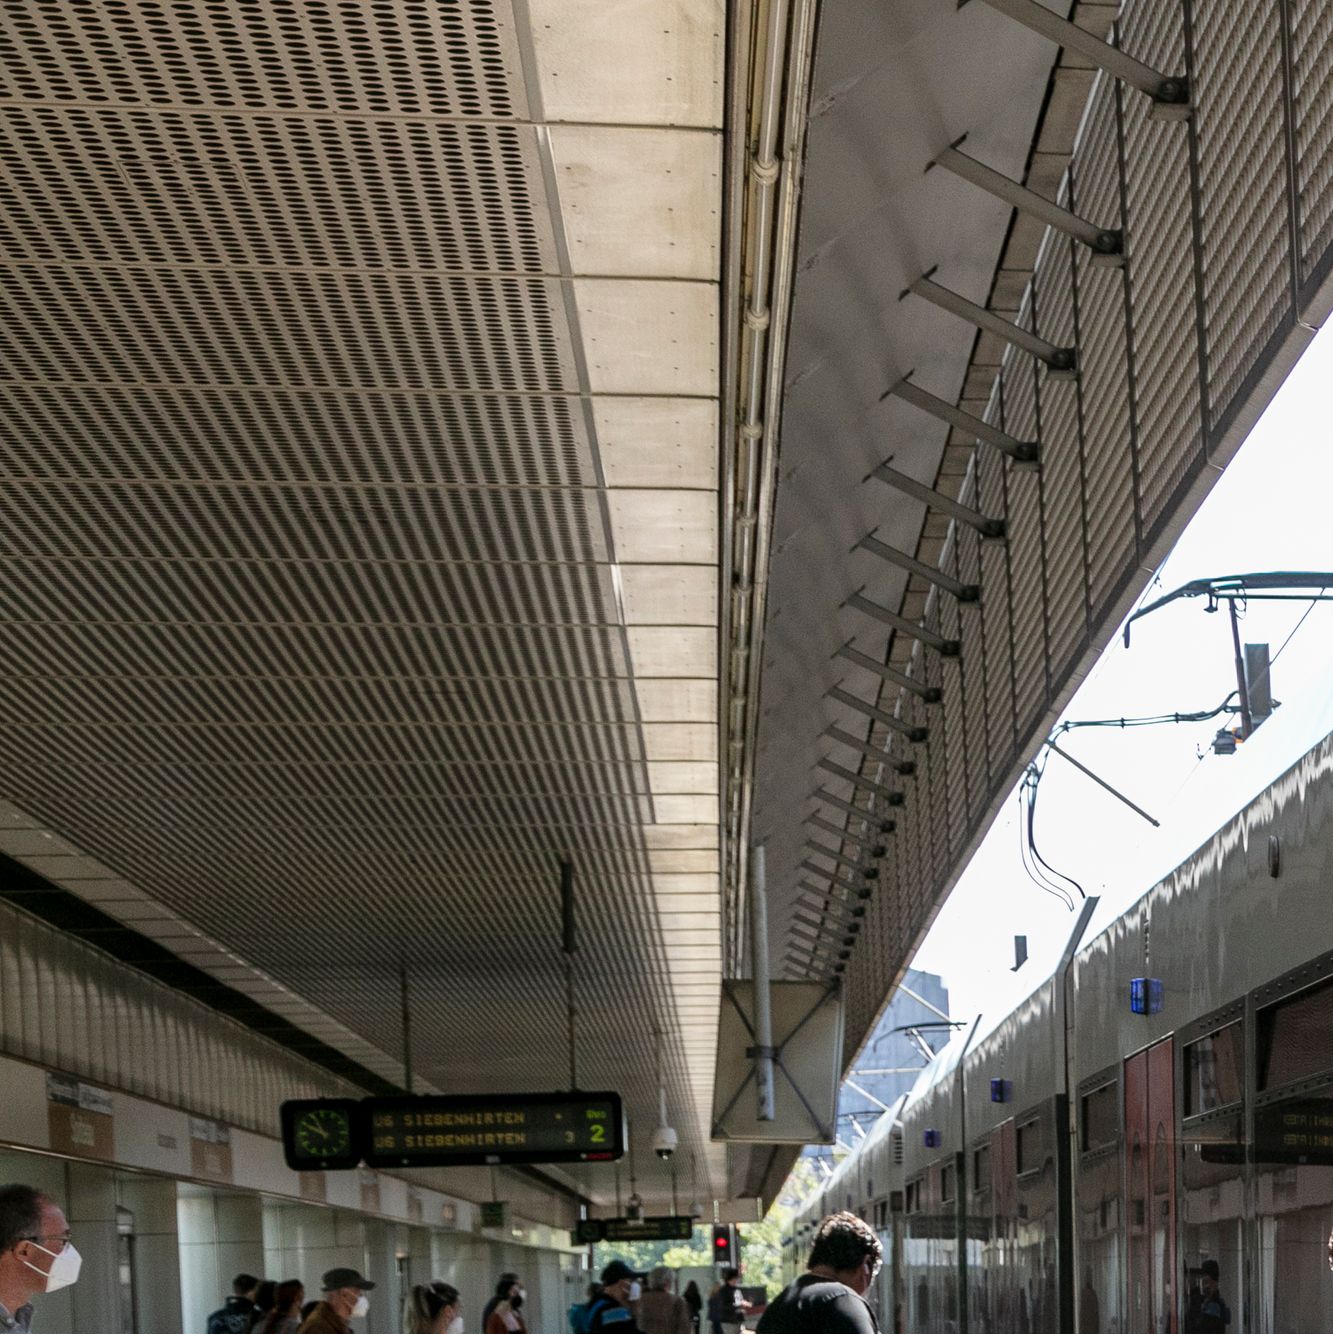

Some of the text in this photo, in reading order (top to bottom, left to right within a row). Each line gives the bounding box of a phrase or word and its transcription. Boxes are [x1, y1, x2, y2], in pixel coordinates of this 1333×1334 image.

[403, 1112, 525, 1127] SIEBENHIRTEN
[403, 1133, 527, 1147] SIEBENHIRTEN
[590, 1124, 605, 1143] 2
